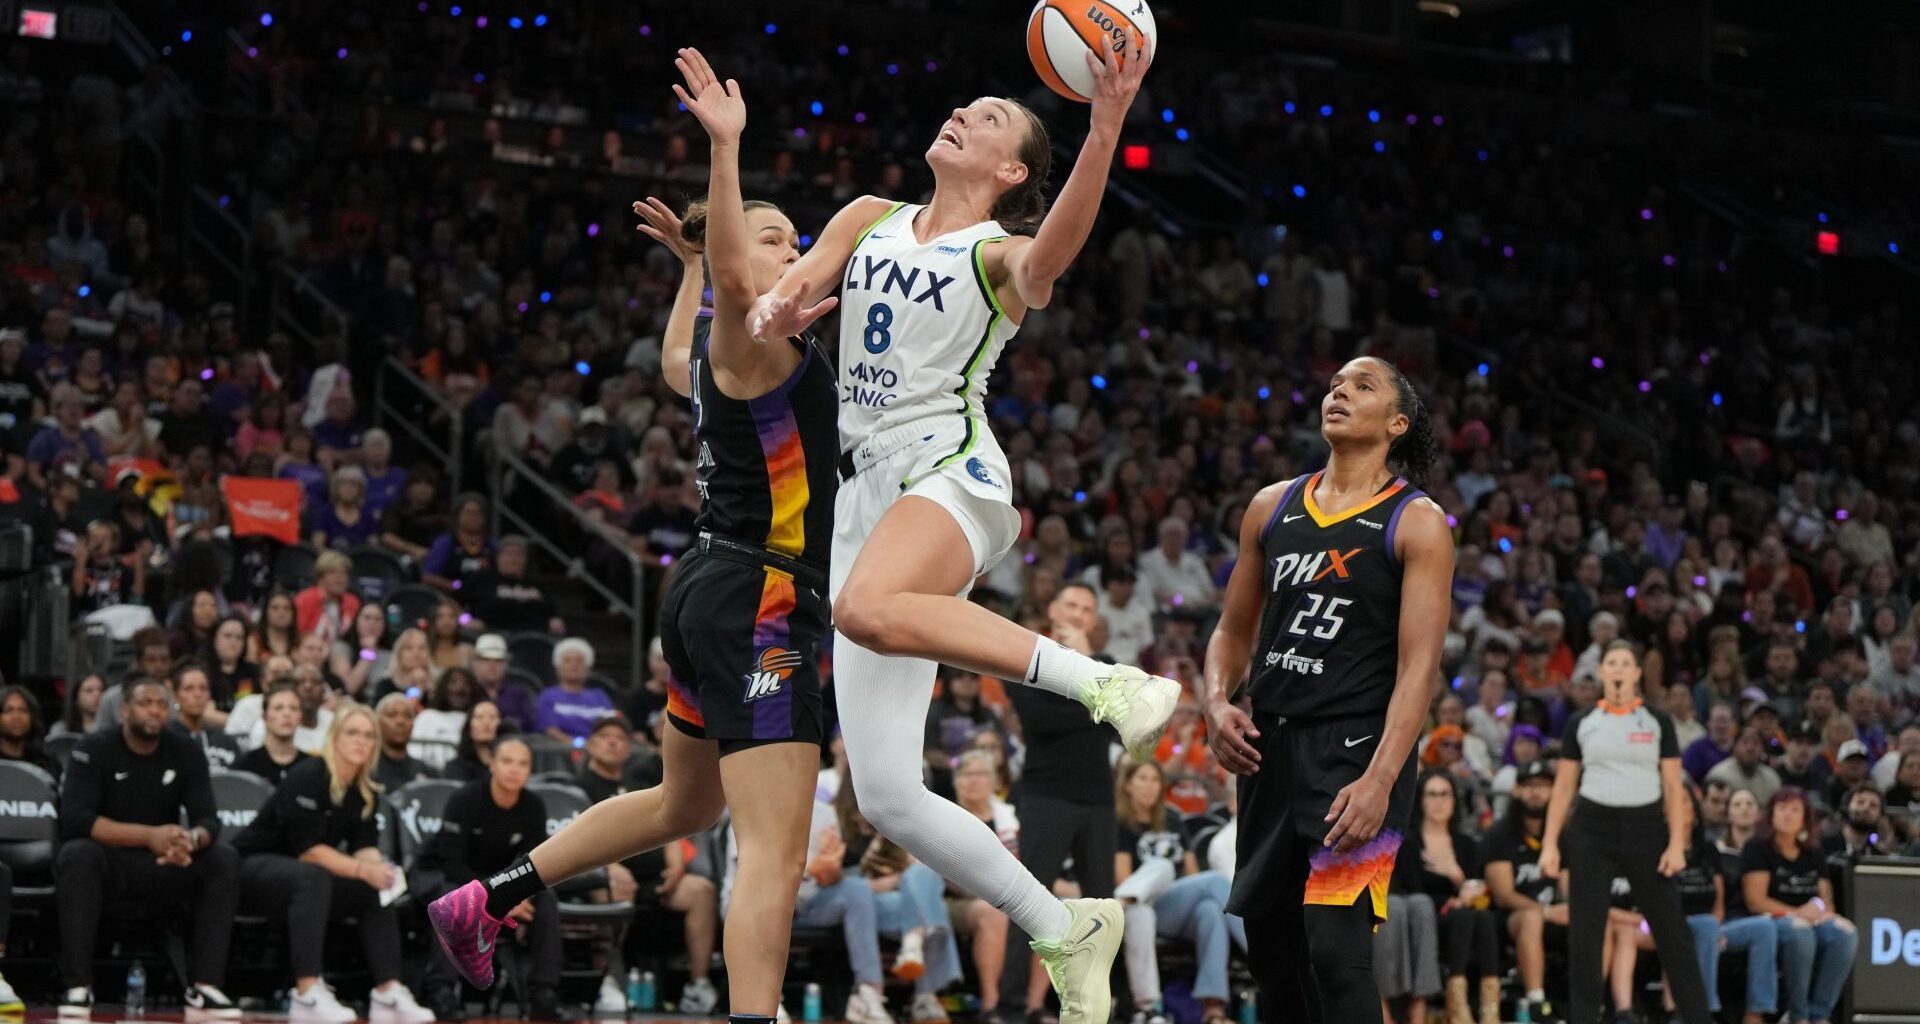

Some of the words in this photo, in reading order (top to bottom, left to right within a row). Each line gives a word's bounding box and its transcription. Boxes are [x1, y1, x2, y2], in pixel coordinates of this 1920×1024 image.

[847, 256, 955, 313] LYNX
[864, 303, 893, 354] 8
[842, 385, 897, 407] INIC
[848, 362, 898, 389] MAYO
[1273, 548, 1364, 592] PHX
[1289, 593, 1354, 640] 25
